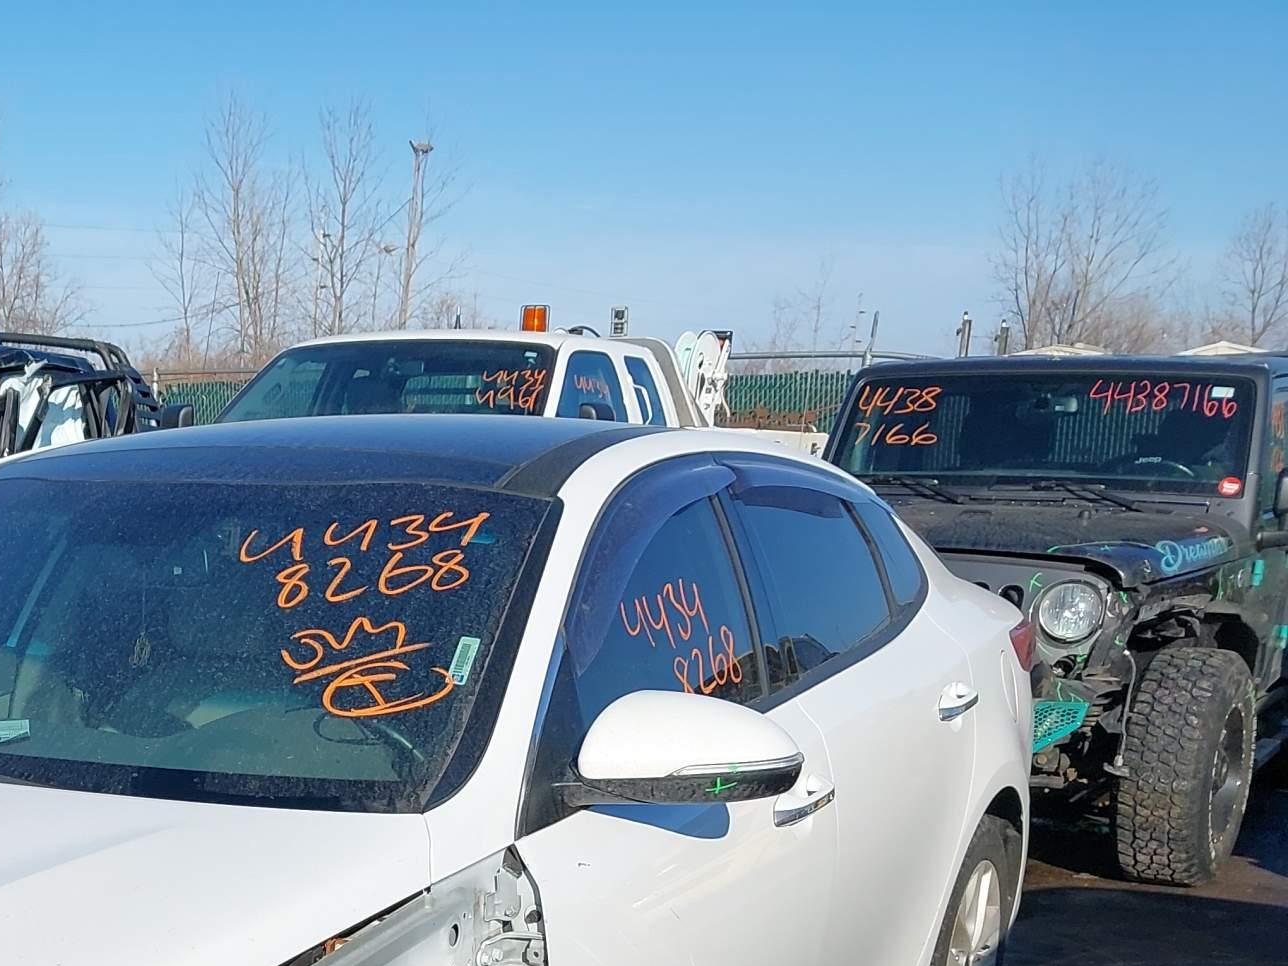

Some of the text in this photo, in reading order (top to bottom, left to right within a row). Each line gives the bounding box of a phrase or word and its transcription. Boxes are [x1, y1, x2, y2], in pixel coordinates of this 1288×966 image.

[858, 385, 943, 416] 4438
[854, 422, 939, 447] 7166
[239, 511, 491, 563] 4434
[274, 550, 470, 608] 8268
[619, 578, 710, 649] 4434
[673, 624, 743, 695] 8268
